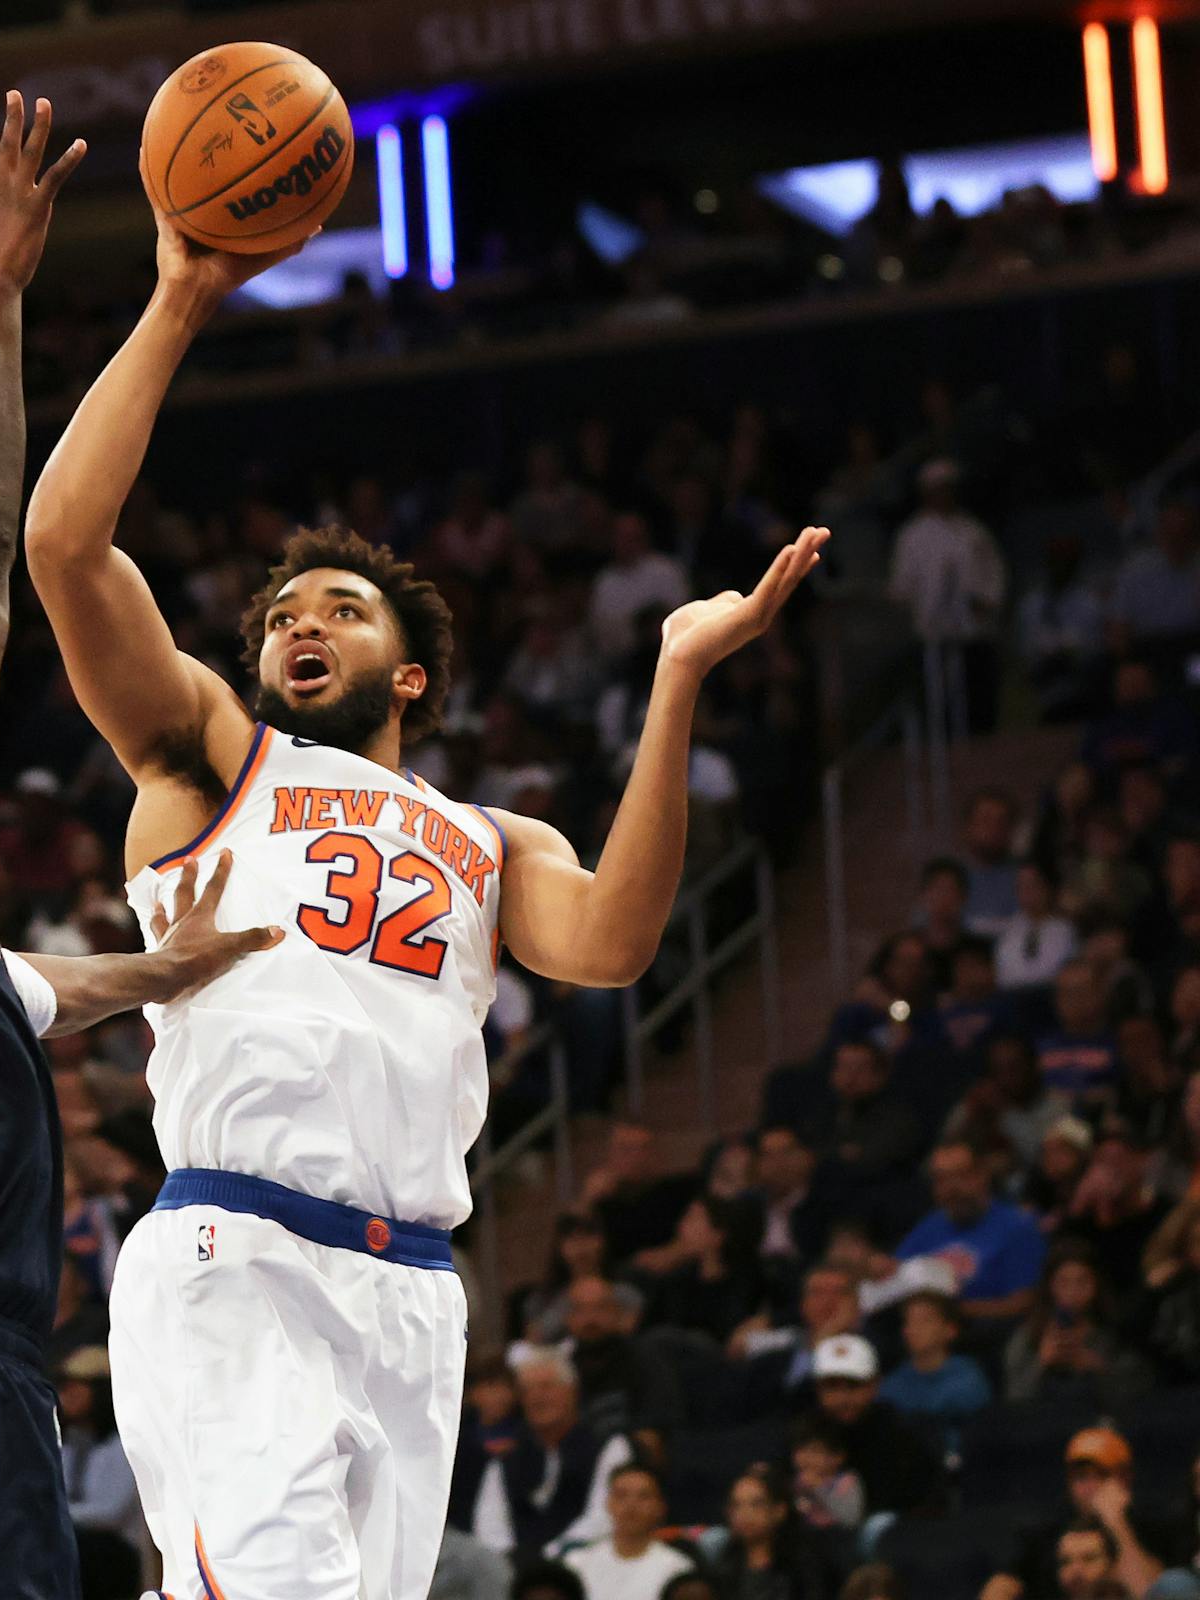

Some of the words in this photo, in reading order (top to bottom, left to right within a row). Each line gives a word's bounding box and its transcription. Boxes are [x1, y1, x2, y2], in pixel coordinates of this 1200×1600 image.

[224, 125, 346, 221] Wilson
[269, 787, 389, 835] NEW
[394, 793, 496, 908] YORK
[296, 830, 452, 980] 32
